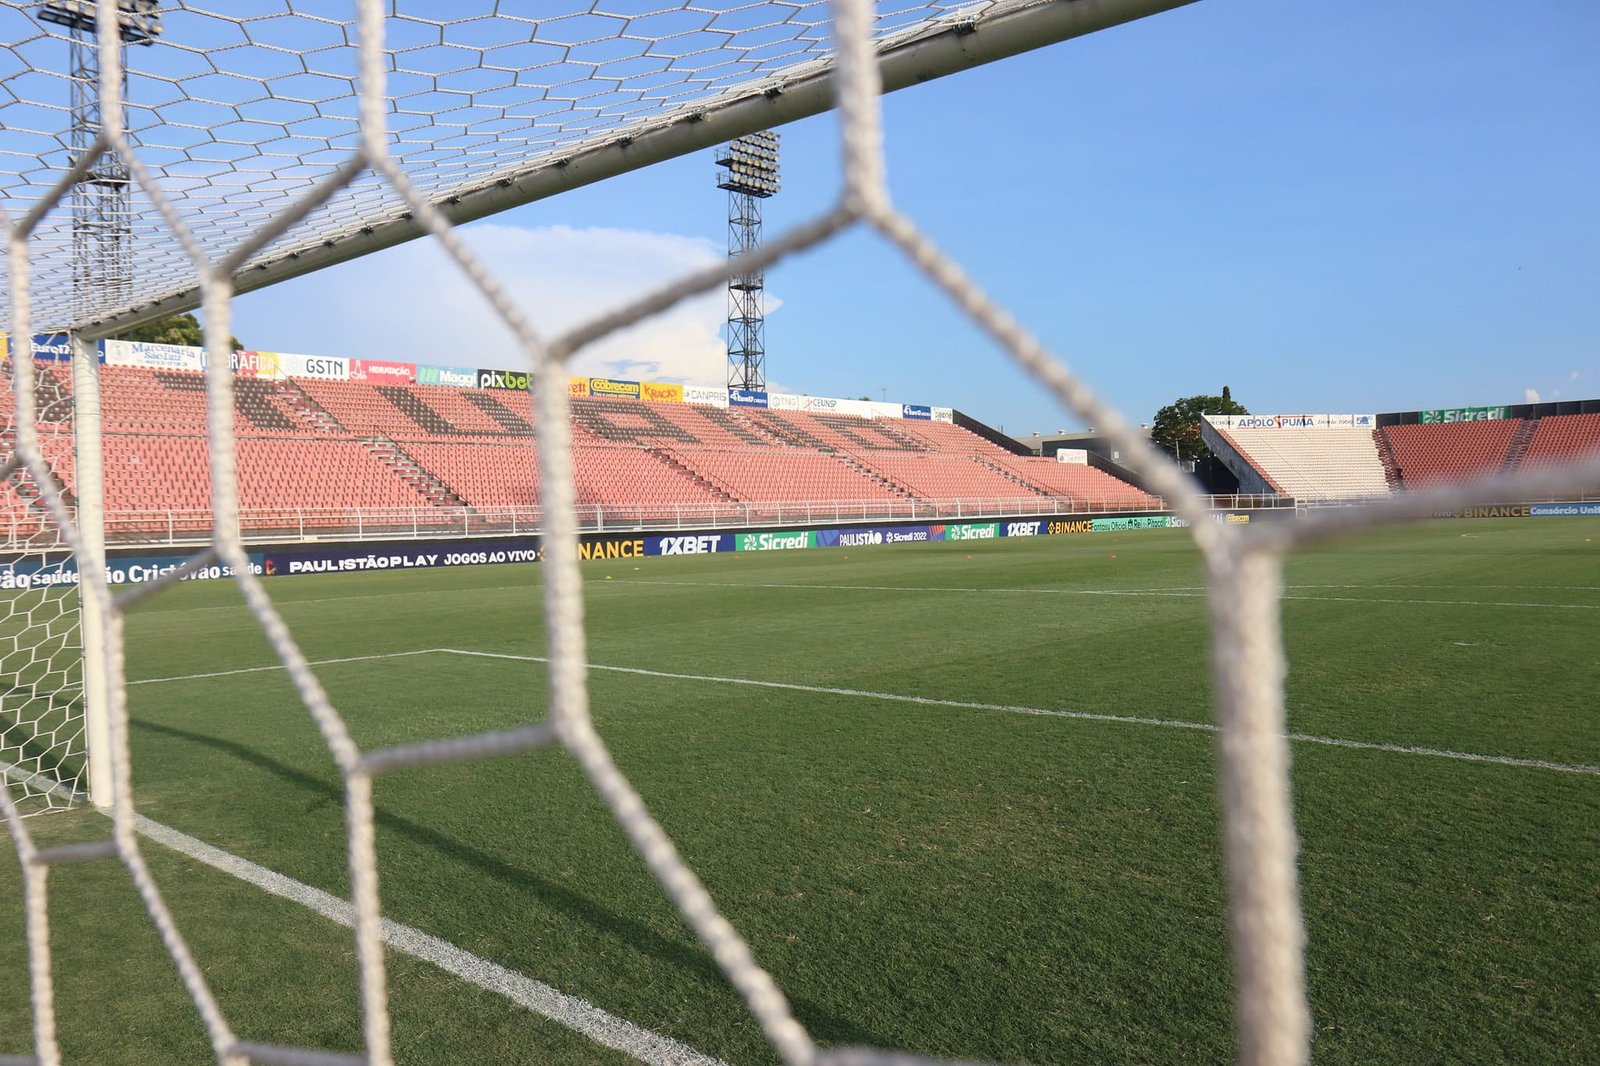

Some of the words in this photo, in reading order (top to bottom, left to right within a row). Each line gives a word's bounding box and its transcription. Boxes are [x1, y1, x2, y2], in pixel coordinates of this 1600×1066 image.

[306, 358, 343, 375] GSTN
[440, 370, 477, 386] Maggi
[480, 370, 534, 391] pixbet
[1443, 403, 1505, 423] Sicredi
[1238, 418, 1274, 427] APOLO
[1464, 506, 1530, 518] BINANCE
[1530, 506, 1578, 515] Consórcio
[960, 522, 995, 540] Sicredi
[1007, 522, 1040, 537] 1XBET
[1055, 520, 1092, 534] BINANCE
[659, 535, 721, 556] 1XBET
[758, 532, 809, 551] Sicredi
[840, 530, 882, 546] PAULISTÃO
[914, 531, 927, 540] 2022
[443, 552, 487, 565] JOGOS
[488, 551, 506, 563] AO
[508, 549, 536, 562] VIVO
[577, 540, 644, 560] NANCE
[0, 569, 28, 589] ão
[32, 569, 79, 585] saúde
[104, 566, 125, 584] ão
[222, 563, 262, 577] sade
